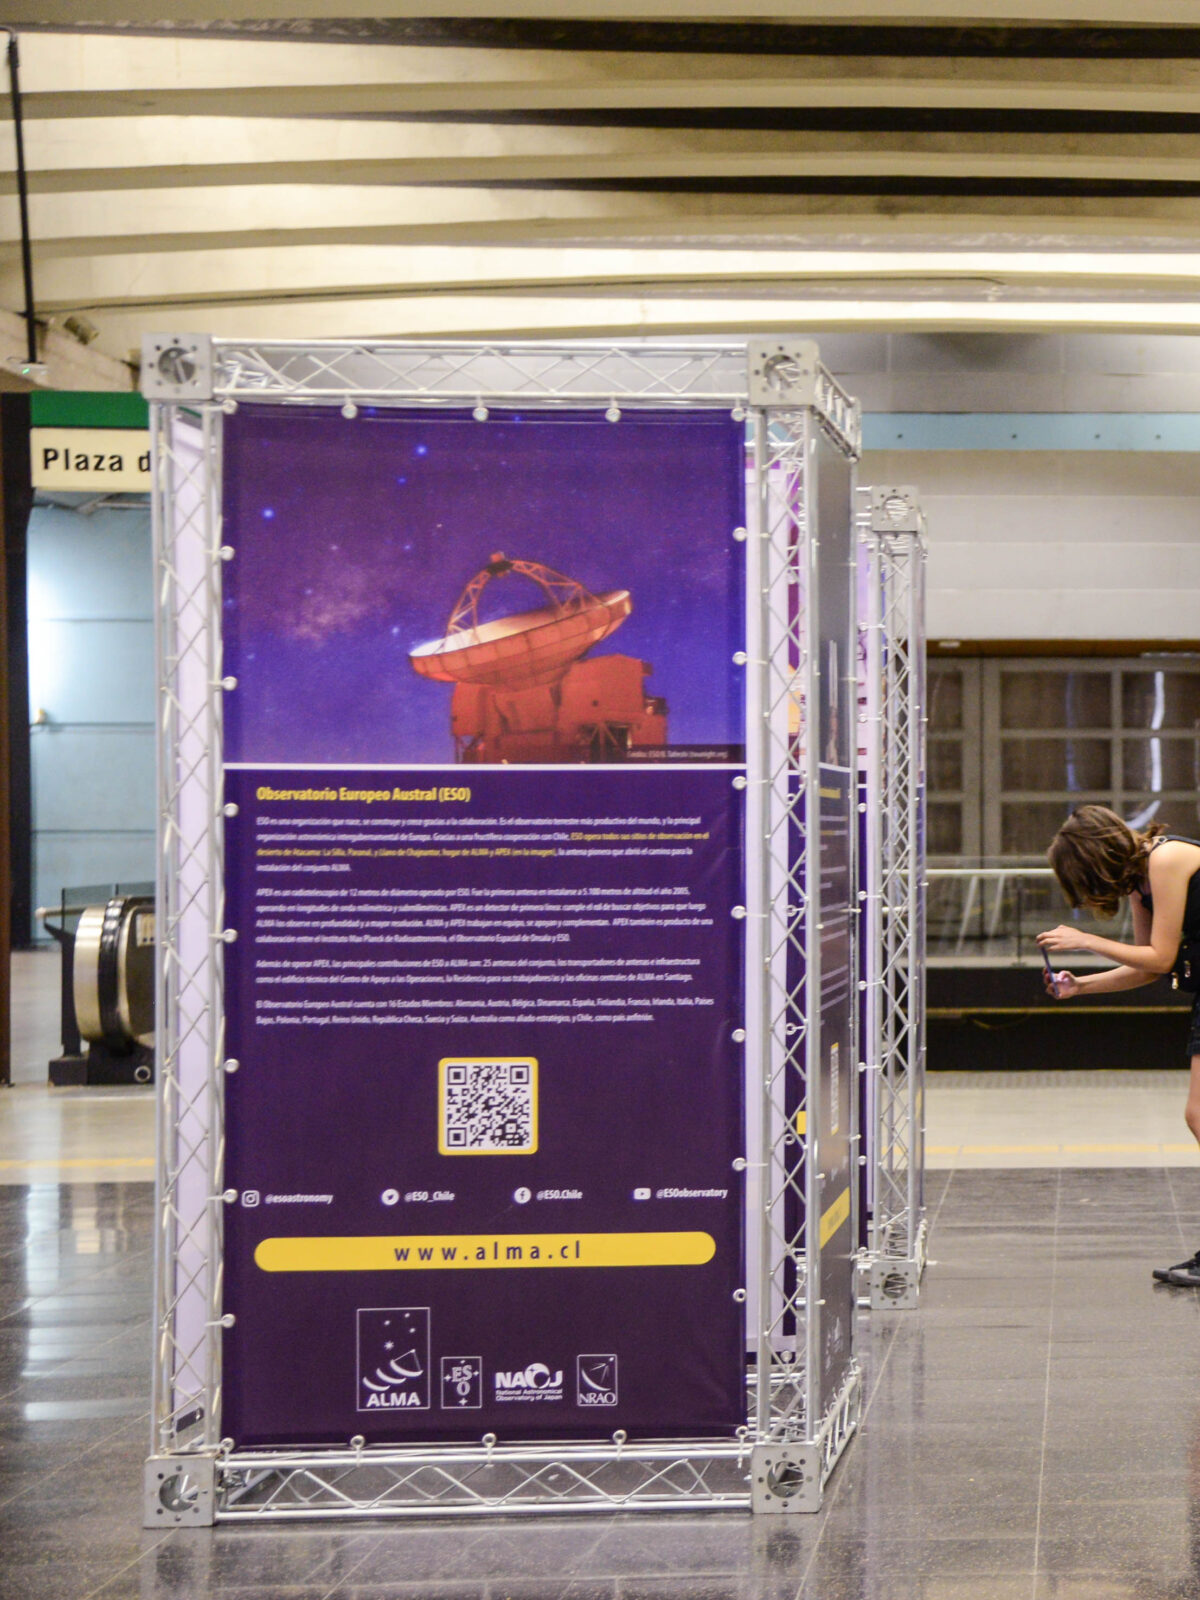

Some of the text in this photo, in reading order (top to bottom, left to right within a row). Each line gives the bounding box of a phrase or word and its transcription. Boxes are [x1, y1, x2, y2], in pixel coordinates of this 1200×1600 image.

[43, 448, 151, 472] Plaza d
[256, 786, 471, 804] Observatorio Europeo Austral (ESO)
[264, 1192, 333, 1205] @esoastronomy
[404, 1190, 455, 1202] @ESO_Chile
[536, 1188, 583, 1200] @ESO.Chile
[656, 1186, 728, 1200] @ESOobservatory
[394, 1240, 581, 1262] www.alma.cl
[495, 1363, 563, 1388] NAOJ
[366, 1392, 421, 1408] ALMA
[579, 1392, 616, 1404] NRAO
